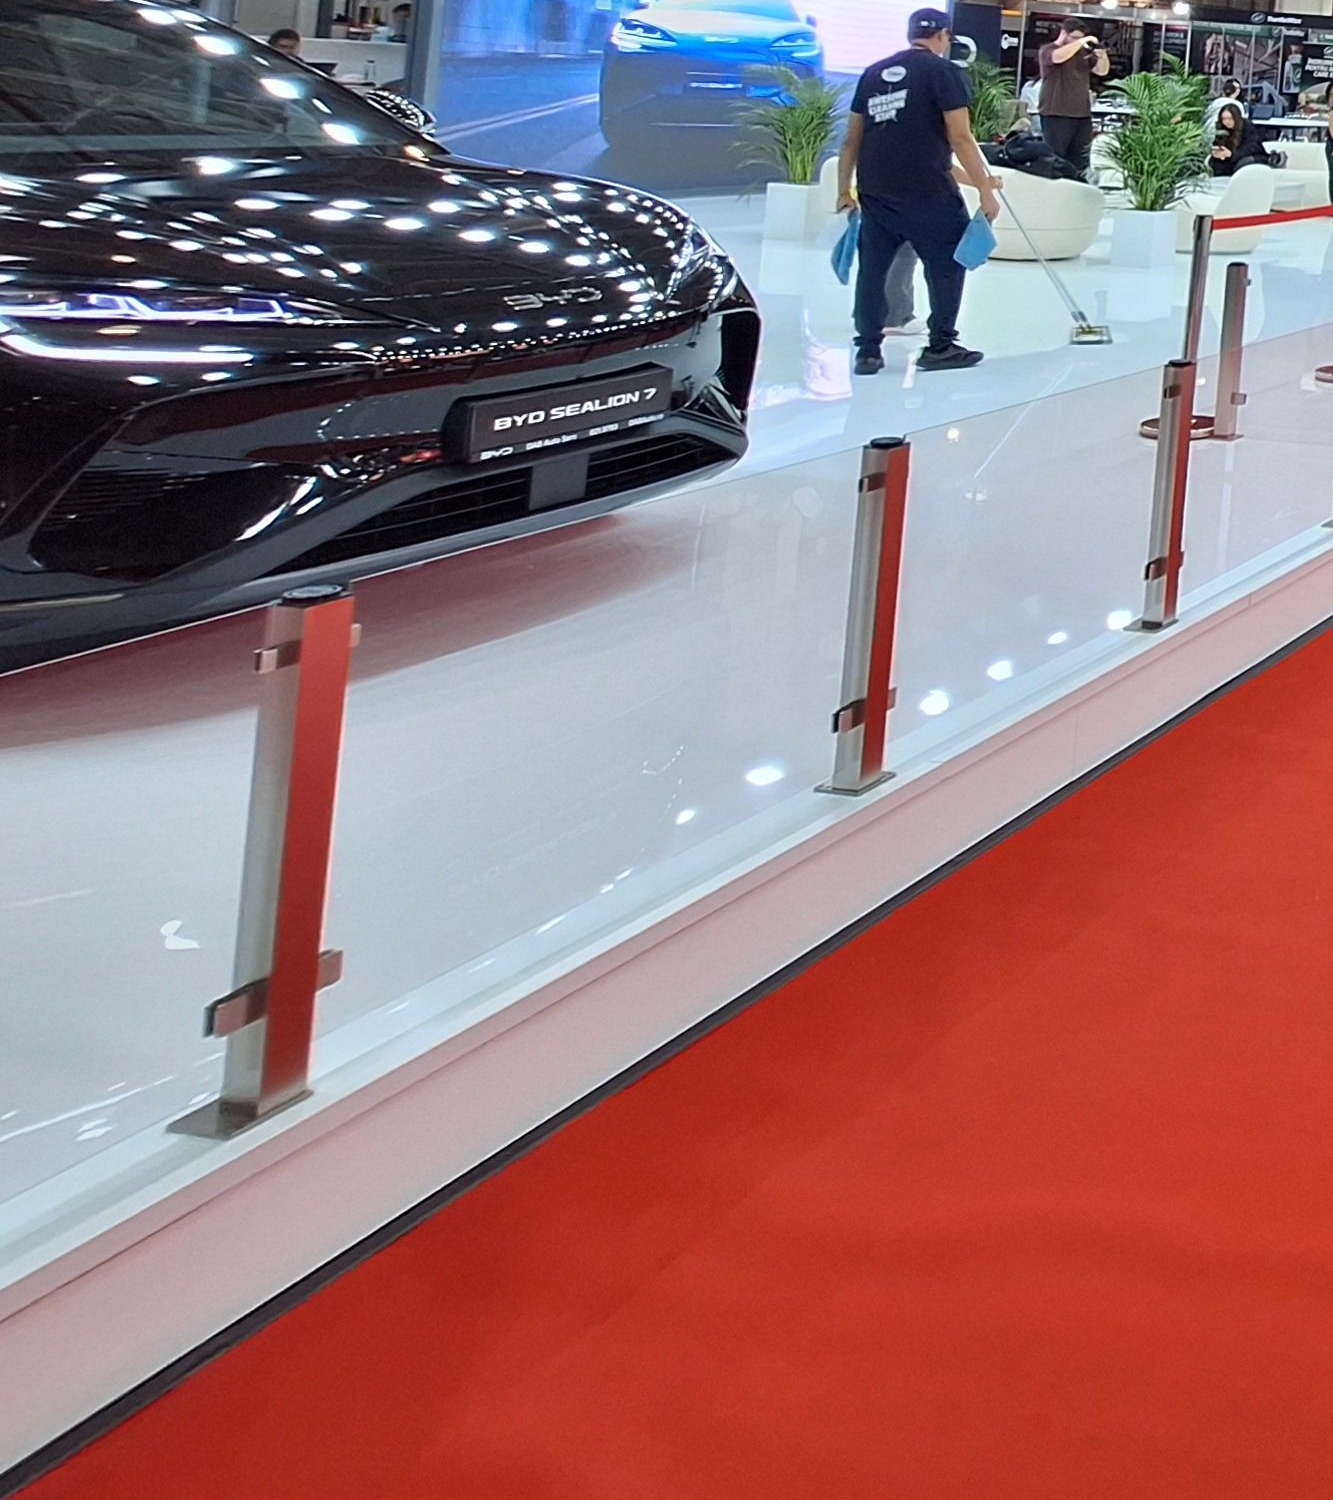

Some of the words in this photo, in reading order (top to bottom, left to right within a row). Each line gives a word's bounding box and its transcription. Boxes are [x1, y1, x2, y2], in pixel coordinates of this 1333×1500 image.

[493, 410, 545, 432] BYD
[549, 390, 640, 420] SEALION
[643, 387, 657, 400] 7
